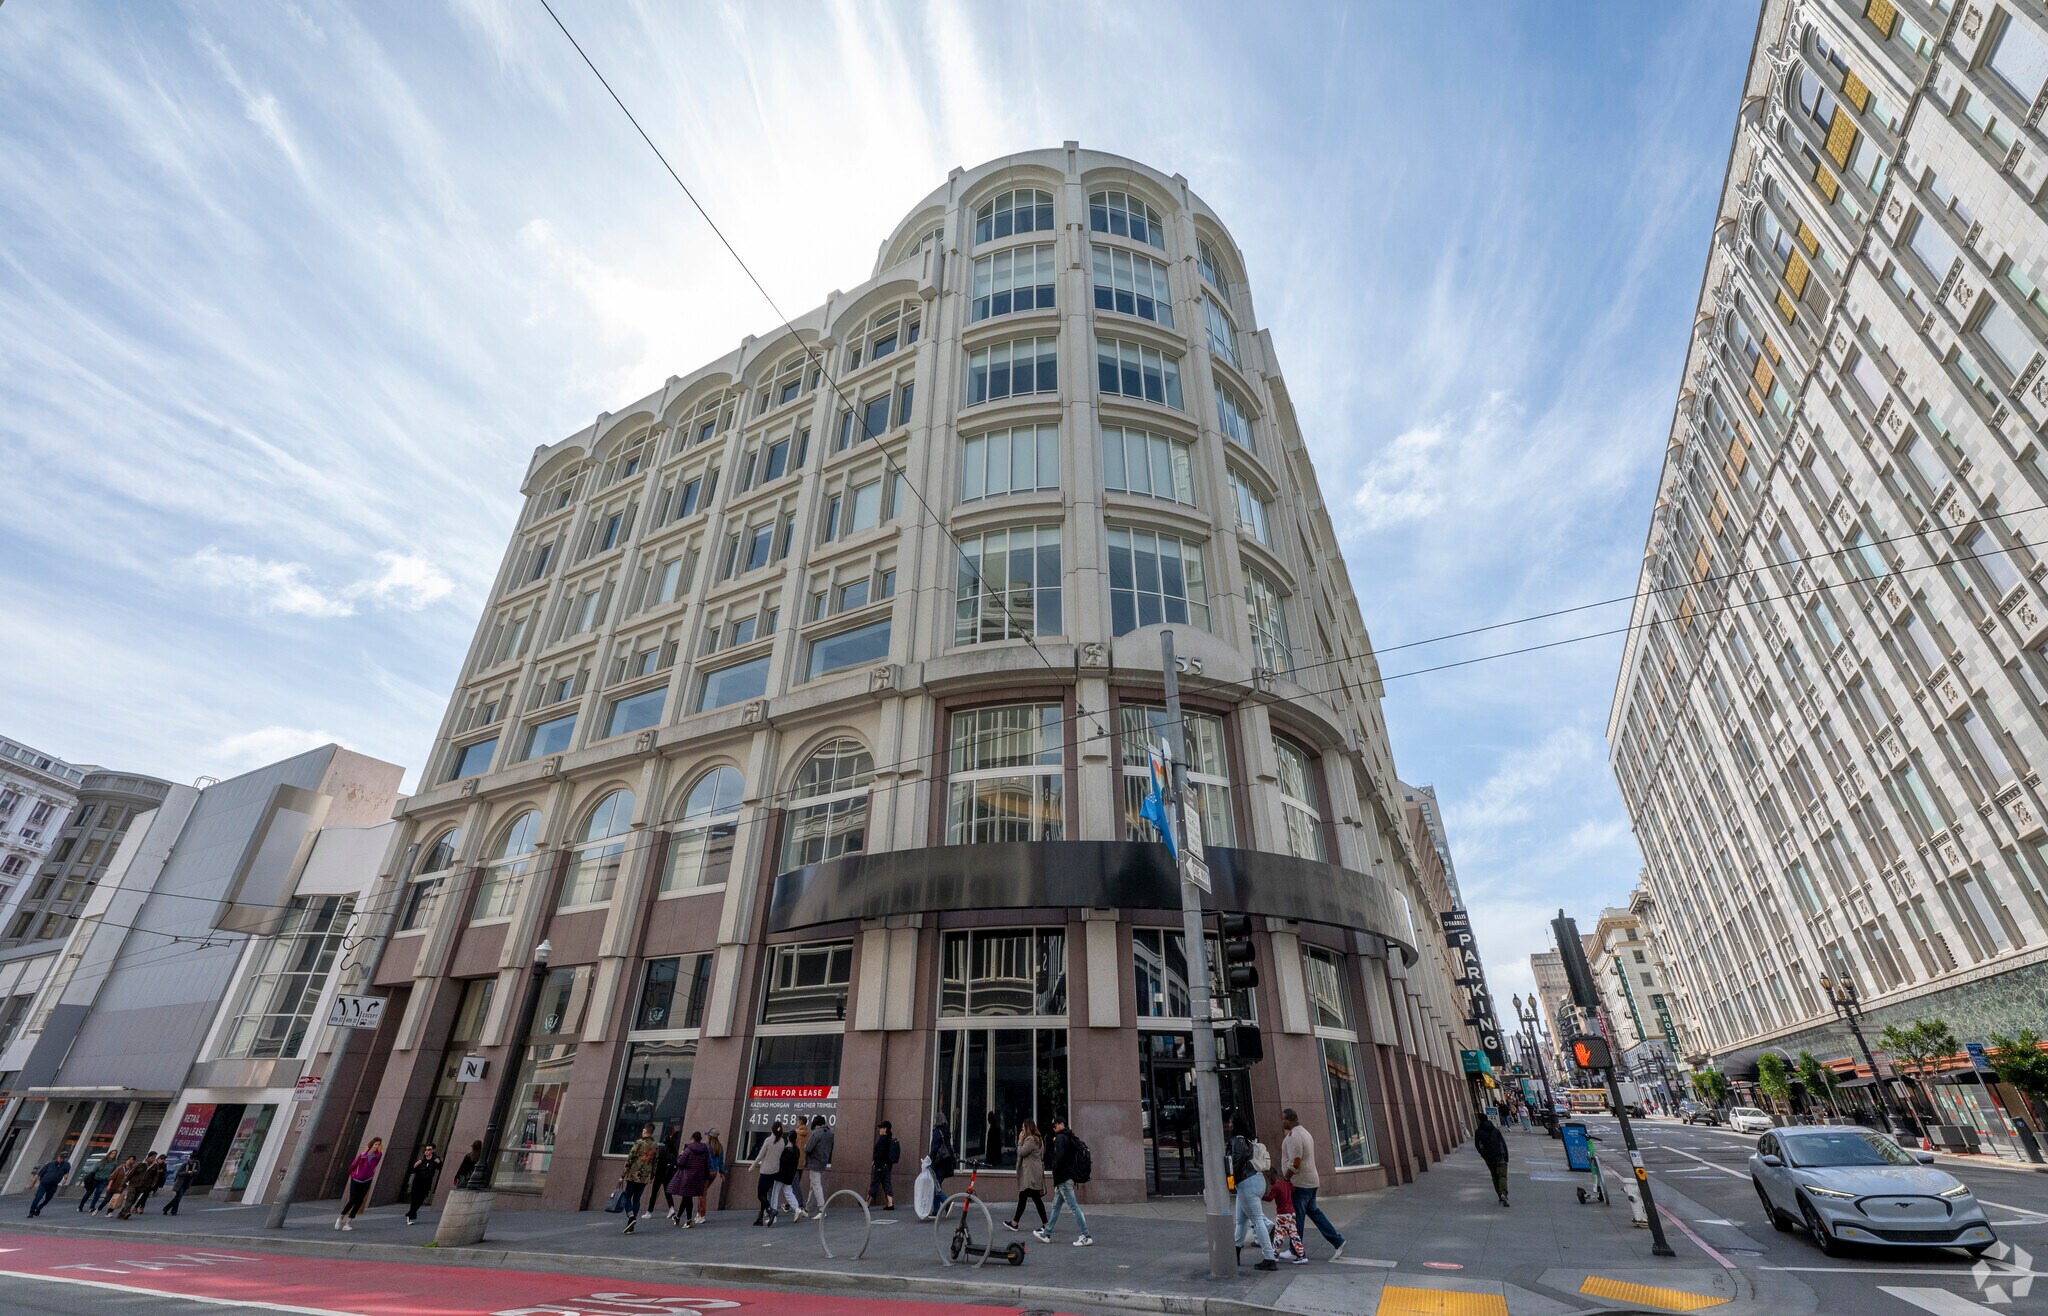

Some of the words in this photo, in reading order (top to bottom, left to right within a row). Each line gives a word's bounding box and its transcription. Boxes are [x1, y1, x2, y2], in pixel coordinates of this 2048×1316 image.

[1175, 654, 1203, 675] 55
[1458, 933, 1498, 1050] PARKING
[1662, 1015, 1679, 1050] HOTEL
[799, 1089, 823, 1097] LEASE
[183, 1114, 201, 1123] RETAIL
[749, 1113, 769, 1125] 415
[774, 1113, 797, 1126] 658
[178, 1126, 189, 1135] FOR
[189, 1127, 206, 1136] LEASE
[48, 1252, 264, 1274] TAXI
